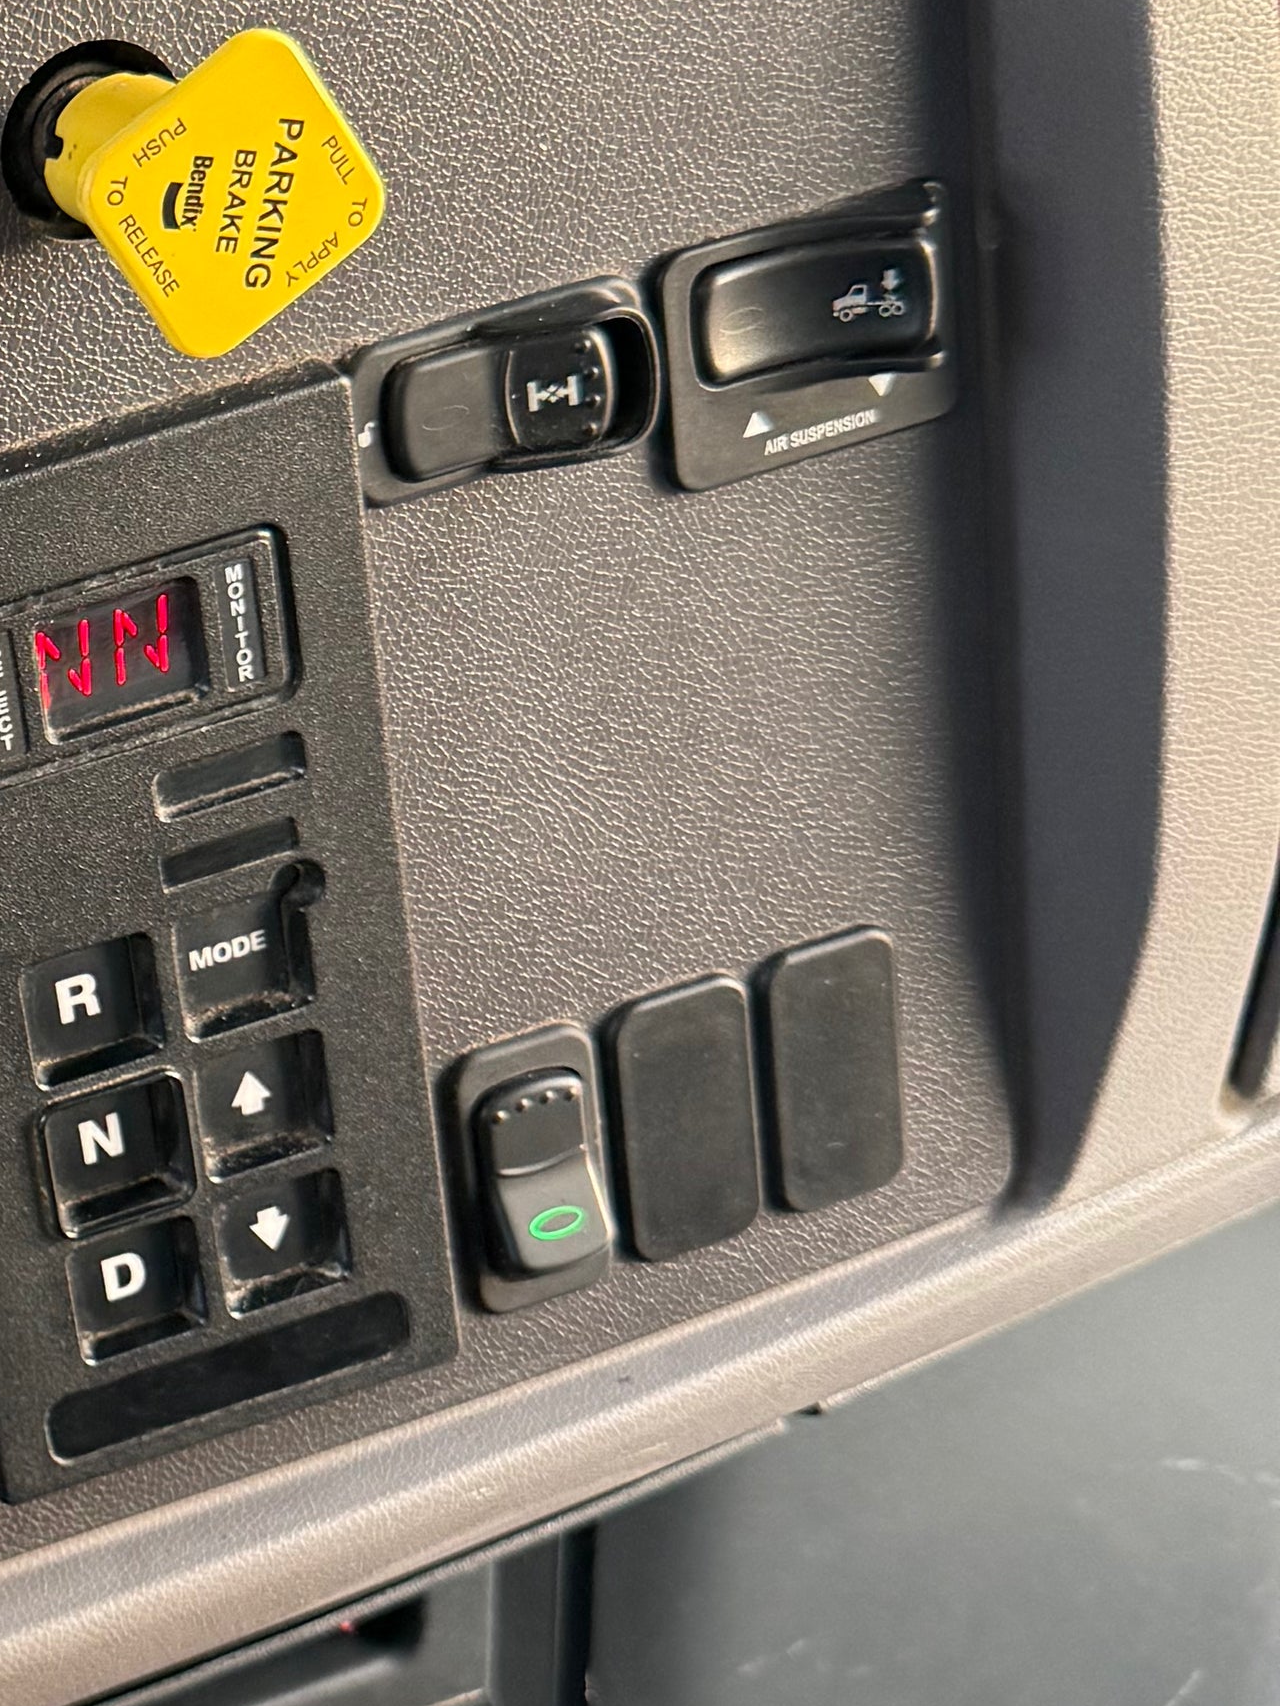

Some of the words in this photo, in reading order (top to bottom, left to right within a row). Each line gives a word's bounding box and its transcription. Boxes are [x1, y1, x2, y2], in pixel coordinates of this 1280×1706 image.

[132, 118, 187, 168] PUSH
[321, 135, 355, 186] PULL
[106, 176, 128, 207] TO
[179, 155, 215, 233] Bendix
[216, 149, 257, 255] BRAKE
[245, 118, 304, 289] PARKING
[347, 196, 368, 227] TO
[118, 213, 180, 298] RELEASE
[286, 232, 338, 288] APPLY
[764, 436, 789, 455] AIR
[790, 408, 879, 448] SUSPENSION
[224, 564, 254, 683] MONITOR
[188, 929, 266, 971] MODE
[54, 973, 102, 1024] R
[78, 1110, 125, 1165] N
[100, 1251, 145, 1300] D
